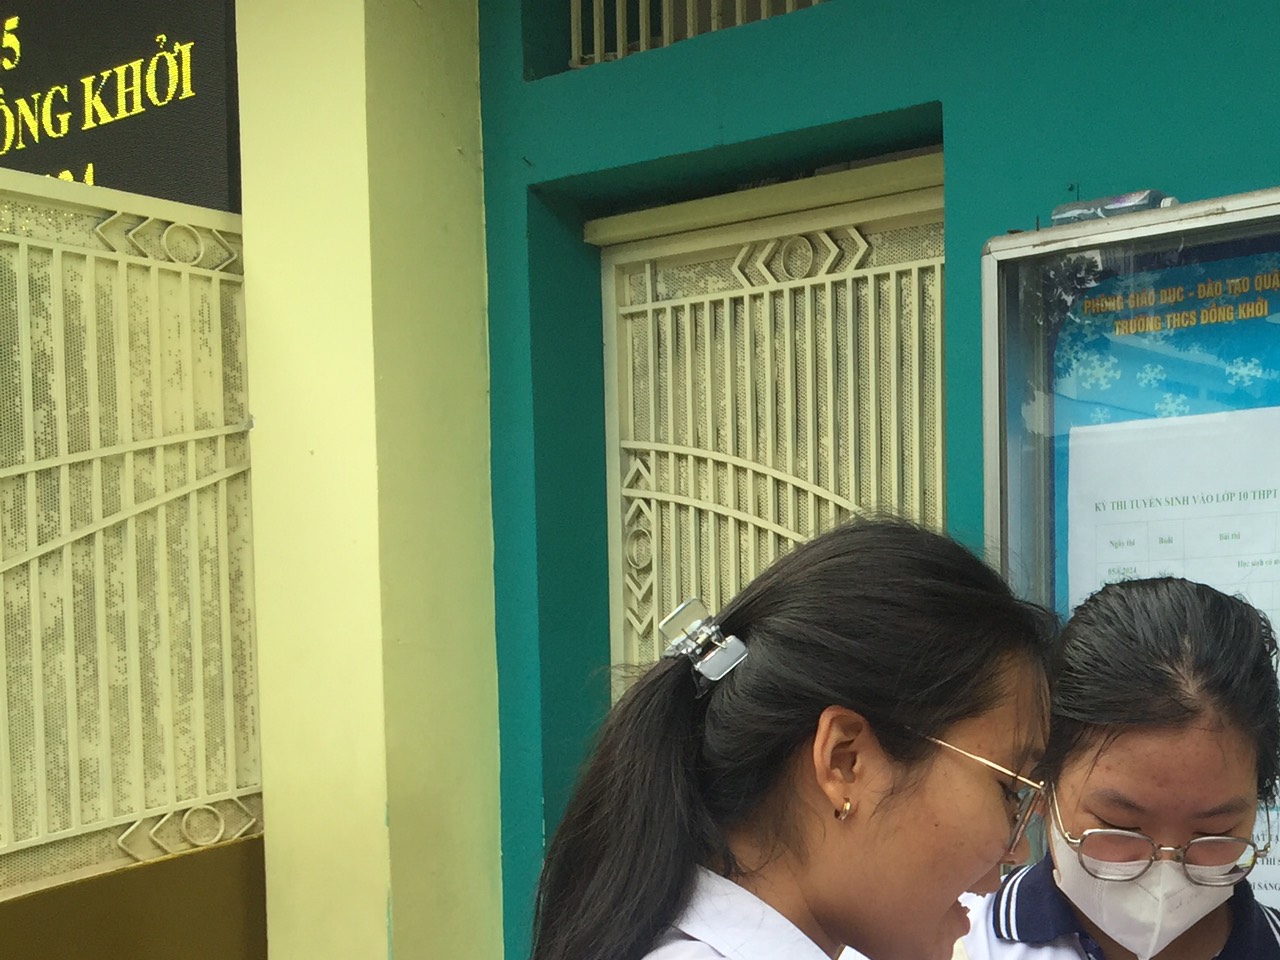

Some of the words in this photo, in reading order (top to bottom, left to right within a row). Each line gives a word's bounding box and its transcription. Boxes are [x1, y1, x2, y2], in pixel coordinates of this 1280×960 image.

[81, 34, 196, 131] KHỞI
[1083, 295, 1124, 315] PHÒNG
[1128, 290, 1156, 310] GIÁO
[1160, 287, 1184, 307] DỤC
[1197, 279, 1223, 299] ĐÀO
[1226, 276, 1250, 298] TẠO
[1113, 312, 1161, 336] TRƯỜNG
[1166, 308, 1197, 328] THCS
[1200, 302, 1236, 325] ĐỒNG
[1238, 296, 1268, 319] KHỞI
[1109, 500, 1127, 510] THI
[1163, 495, 1189, 506] SINH
[1191, 491, 1214, 504] VÀO
[1214, 492, 1234, 502] LỚP
[1238, 491, 1248, 500] 10
[1251, 488, 1278, 499] THPT
